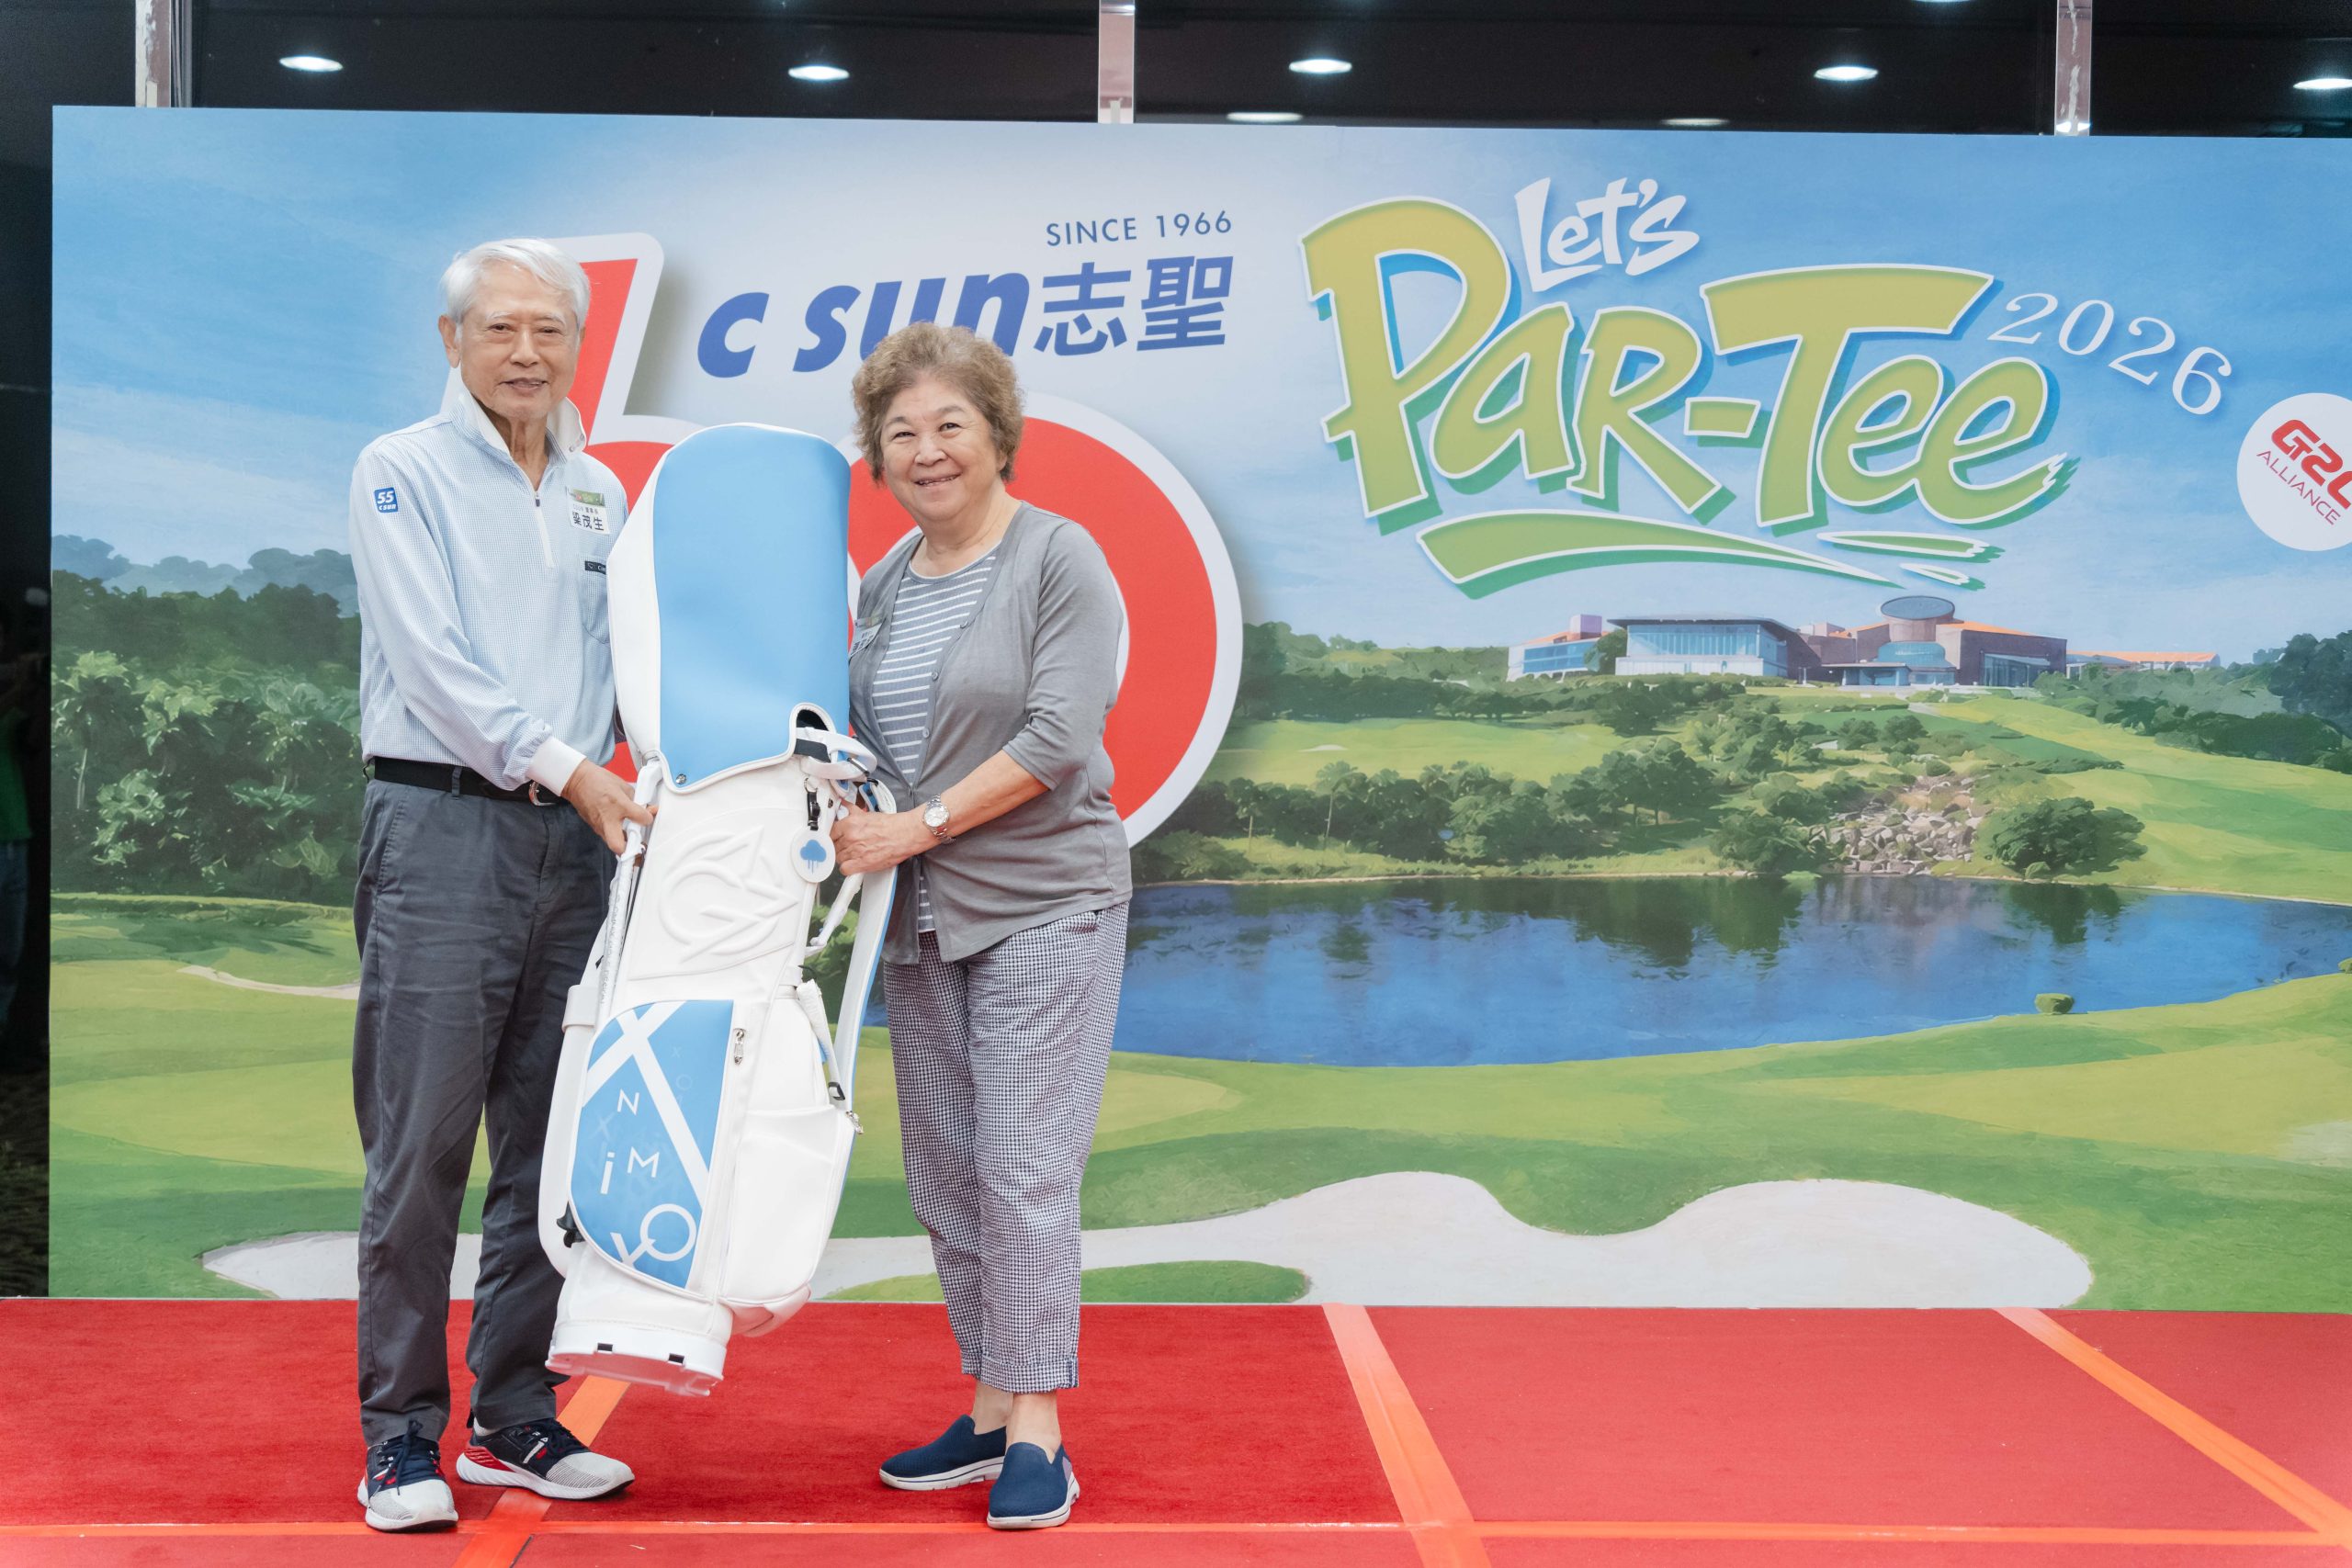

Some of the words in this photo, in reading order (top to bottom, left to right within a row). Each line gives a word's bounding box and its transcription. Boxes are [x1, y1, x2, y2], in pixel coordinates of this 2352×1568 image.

[1046, 216, 1136, 247] SINCE
[1156, 211, 1233, 238] 1966
[1515, 177, 1700, 292] Let's
[1033, 255, 1234, 356] 志聖
[1987, 293, 2232, 414] 2026
[377, 490, 394, 504] 55
[2256, 450, 2341, 525] ALLIANCE
